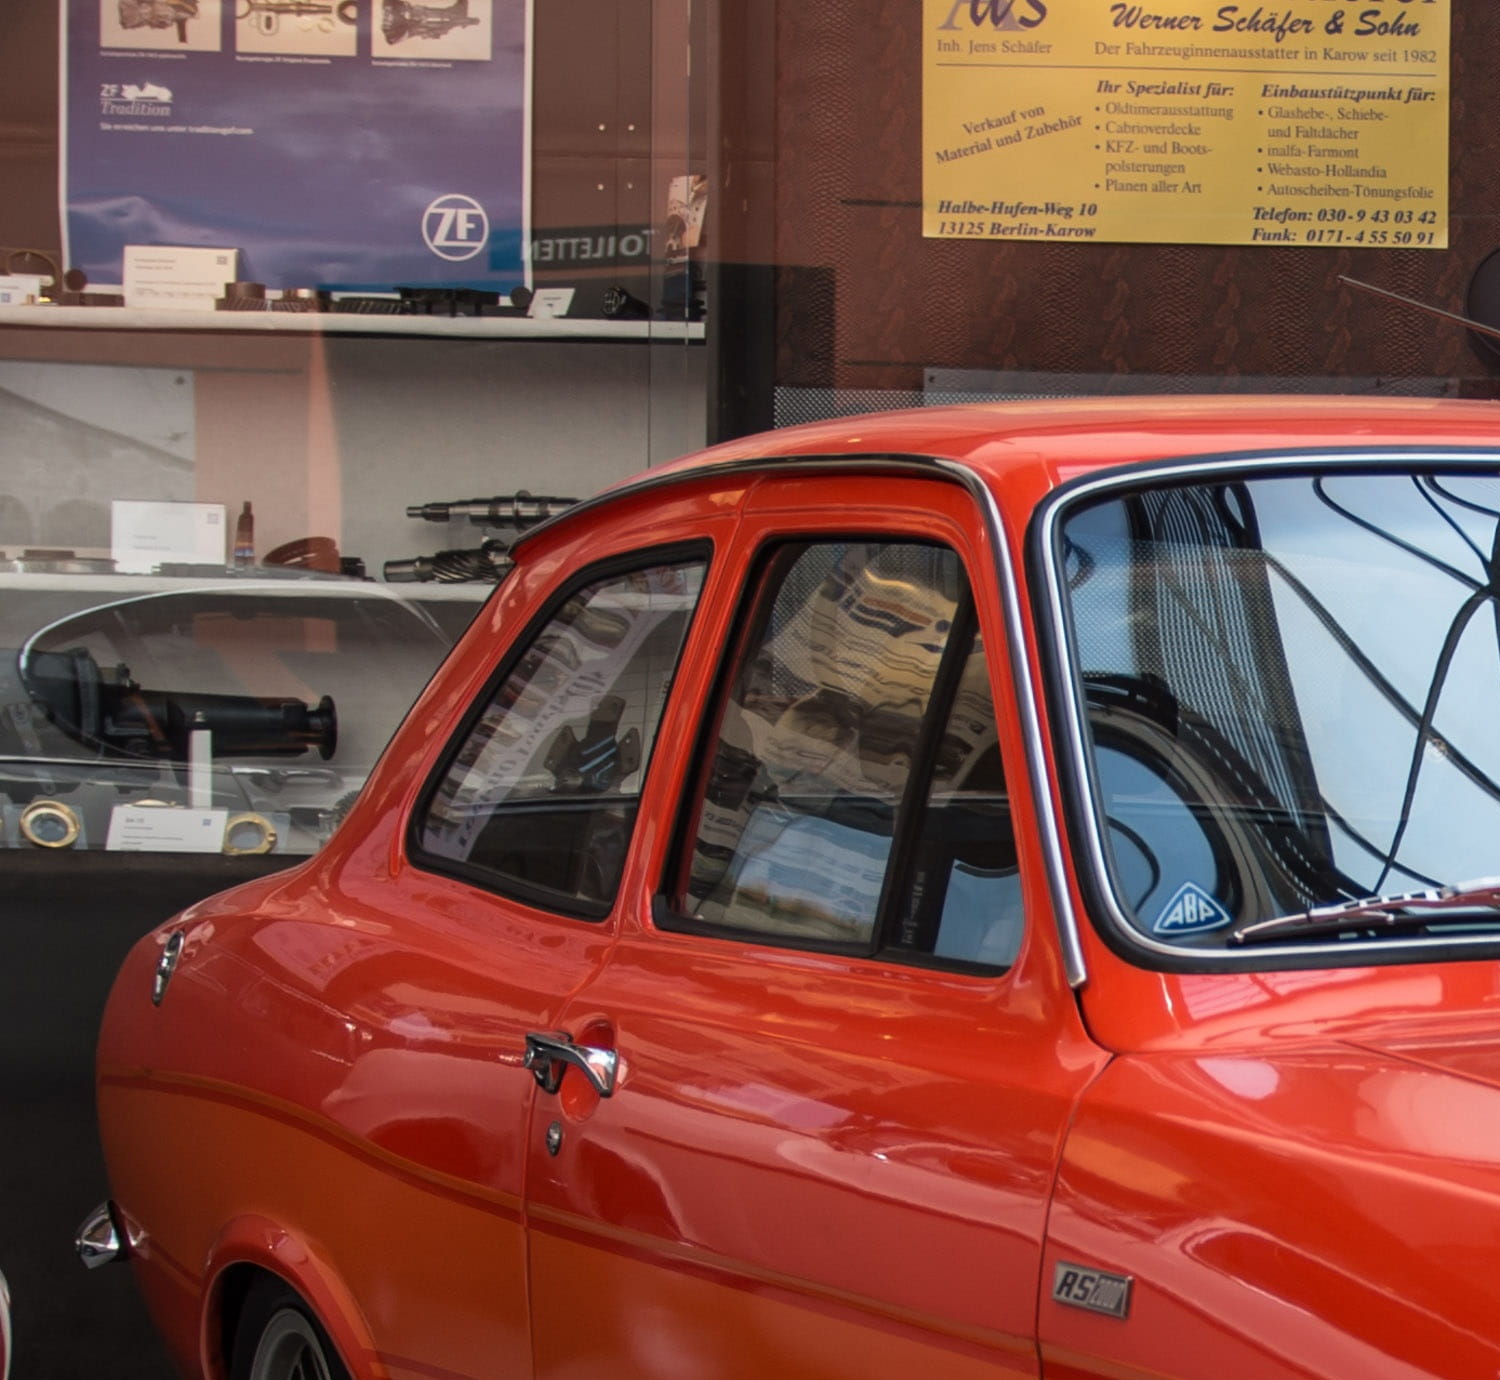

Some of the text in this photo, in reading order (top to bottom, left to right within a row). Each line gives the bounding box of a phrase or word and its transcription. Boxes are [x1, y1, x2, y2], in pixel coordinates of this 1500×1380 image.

[1110, 2, 1421, 43] Werner Schäfer & Sohn
[968, 40, 997, 56] Jens
[1001, 40, 1053, 55] Schäfer
[1094, 41, 1438, 64] Der Fahrzeuginnenausstatter in Karow seit 1982
[100, 84, 119, 98] ZF
[1096, 80, 1235, 99] Ihr Spezialist für:
[1260, 83, 1437, 104] Einbaustützpunkt für:
[100, 100, 172, 117] Tradition
[1105, 102, 1235, 120] Oldtimerausstattung
[1337, 107, 1390, 121] Schiebe-
[962, 105, 1046, 136] Verkauf von
[1105, 121, 1202, 136] Cabrioverdecke
[935, 115, 1084, 165] Material und Zubehör
[1267, 126, 1360, 141] und Faltdächer
[1105, 140, 1213, 156] KFZ- und Boots-
[1105, 160, 1186, 176] polsterungen
[1267, 163, 1388, 179] Webasto-Hollandia
[1105, 179, 1202, 194] Planen aller Art
[1267, 183, 1435, 202] Autoscheiben-Tönungsfolie
[937, 200, 1098, 220] Halbe-Hufen-Weg 10
[1252, 206, 1437, 225] Telefon: 43 03 42
[431, 207, 480, 246] ZF
[938, 220, 1098, 238] 13125 Berlin-Karow
[1252, 227, 1435, 245] Funk: 55 50 91
[1055, 1270, 1097, 1302] RS
